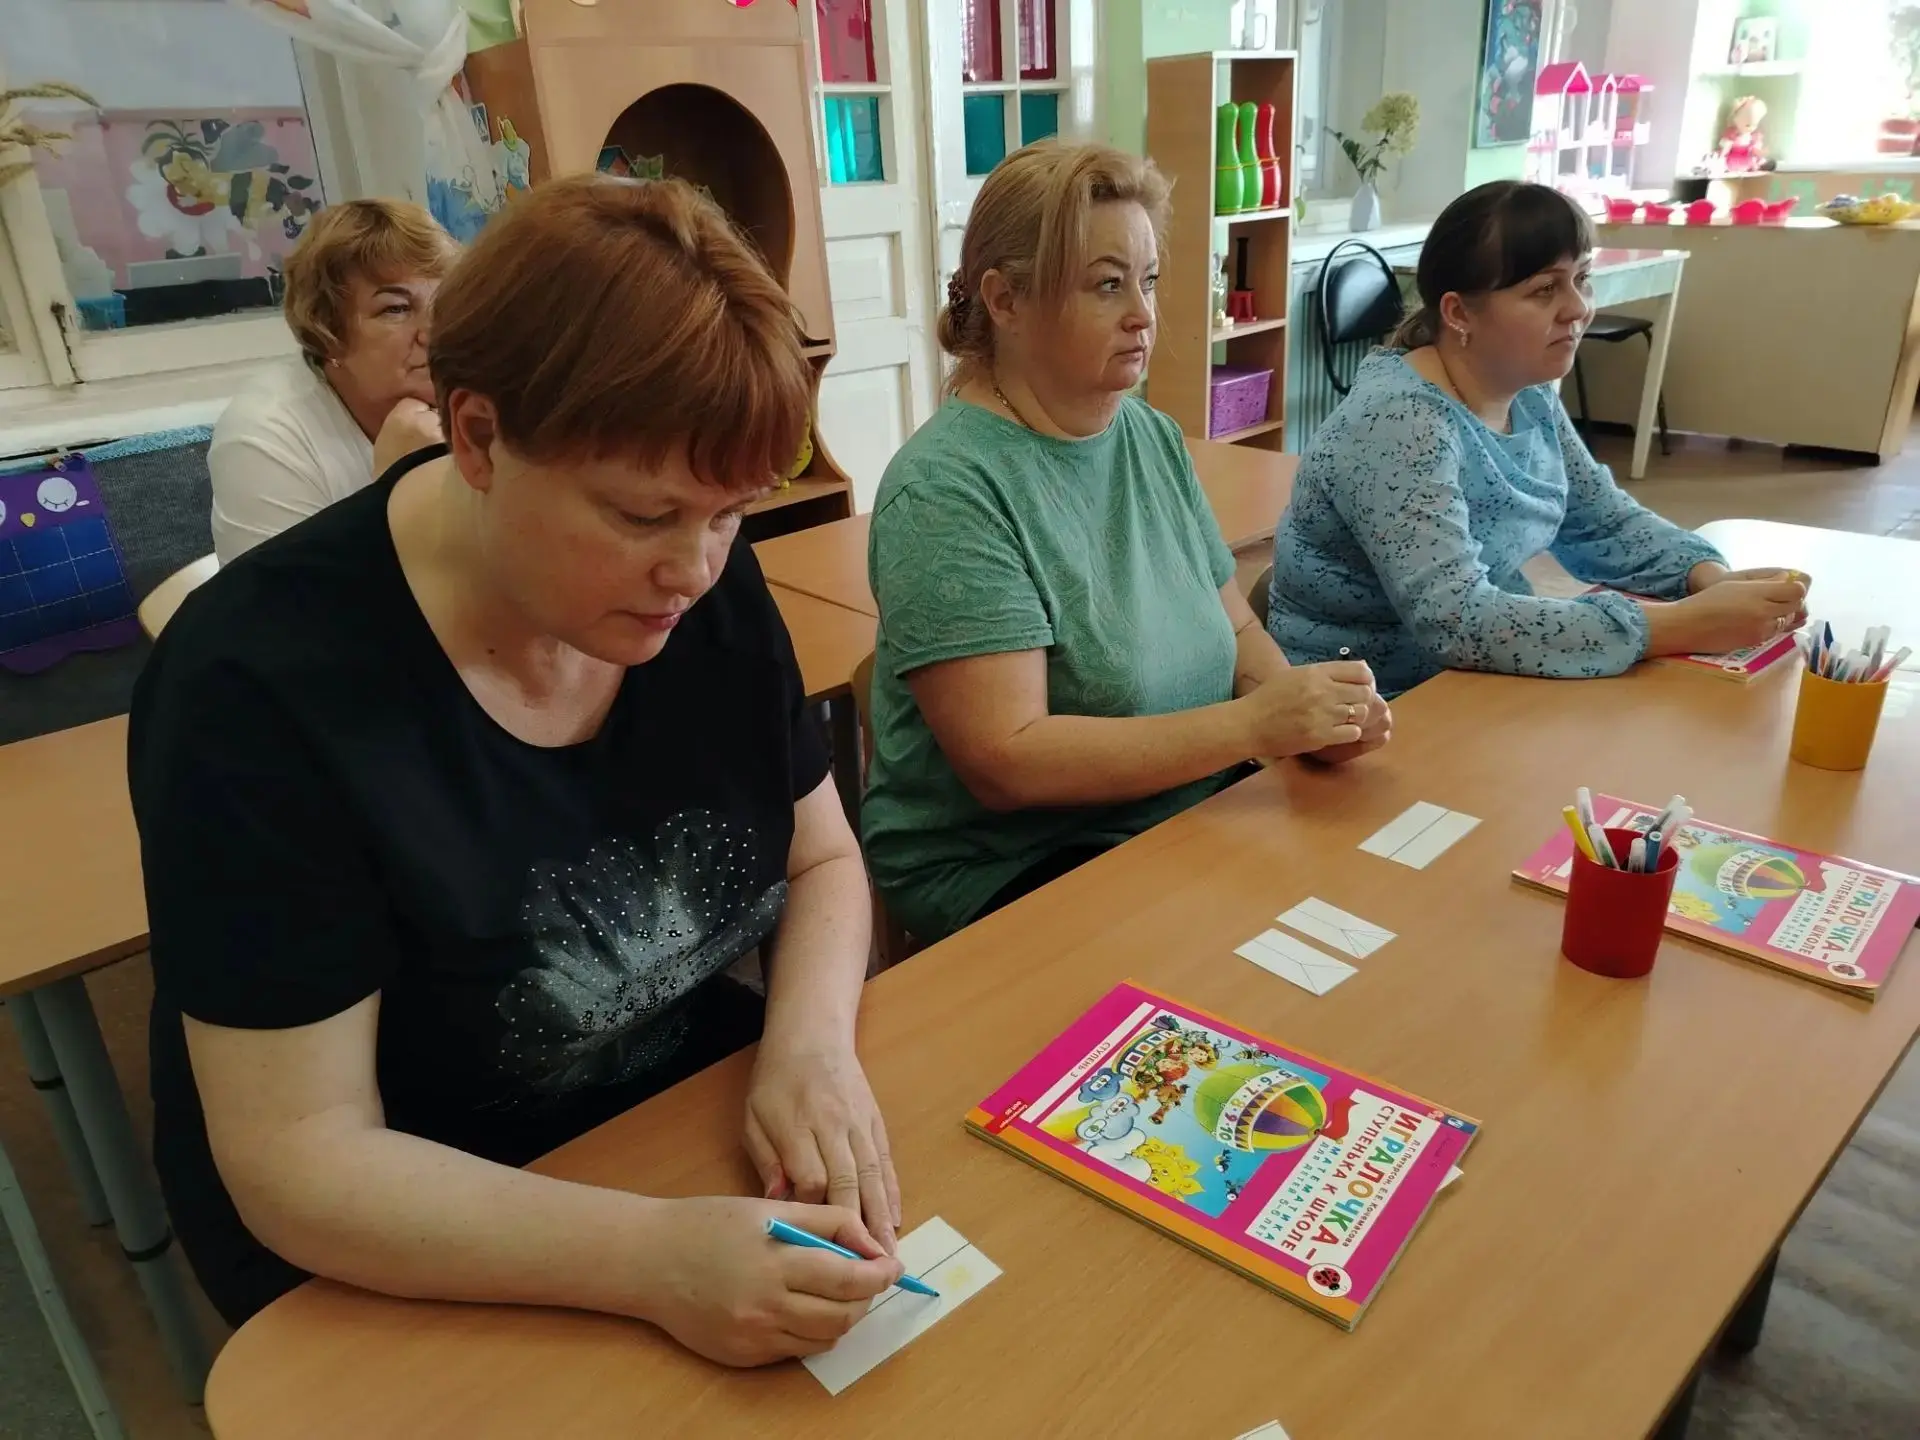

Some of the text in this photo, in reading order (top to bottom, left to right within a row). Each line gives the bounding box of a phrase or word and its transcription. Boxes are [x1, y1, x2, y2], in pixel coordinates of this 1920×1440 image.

[1824, 871, 1860, 916] СТУПЕНЬКА
[1822, 875, 1886, 952] ИГРАЛОЧКА
[1799, 925, 1827, 955] ШКОЛЕ
[1078, 1041, 1111, 1071] СТУПЕНЬ
[1245, 1086, 1259, 1095] 7
[1260, 1077, 1272, 1085] 6
[1225, 1112, 1237, 1122] 9
[1231, 1098, 1245, 1108] 8
[1219, 1126, 1234, 1141] 10
[1312, 1141, 1330, 1162] ДЛЯ
[1280, 1105, 1395, 1251] СТУПЕНЬКА К ШКОЛЕ
[1287, 1163, 1313, 1196] ДЕТЕЙ
[1311, 1112, 1422, 1245] ИГРАЛОЧКА
[1386, 1154, 1413, 1185] Петерсон,
[1264, 1146, 1341, 1242] МАТЕМАТИКА
[1255, 1218, 1272, 1237] ЛЕТ
[1342, 1202, 1379, 1248] Кочемасова
